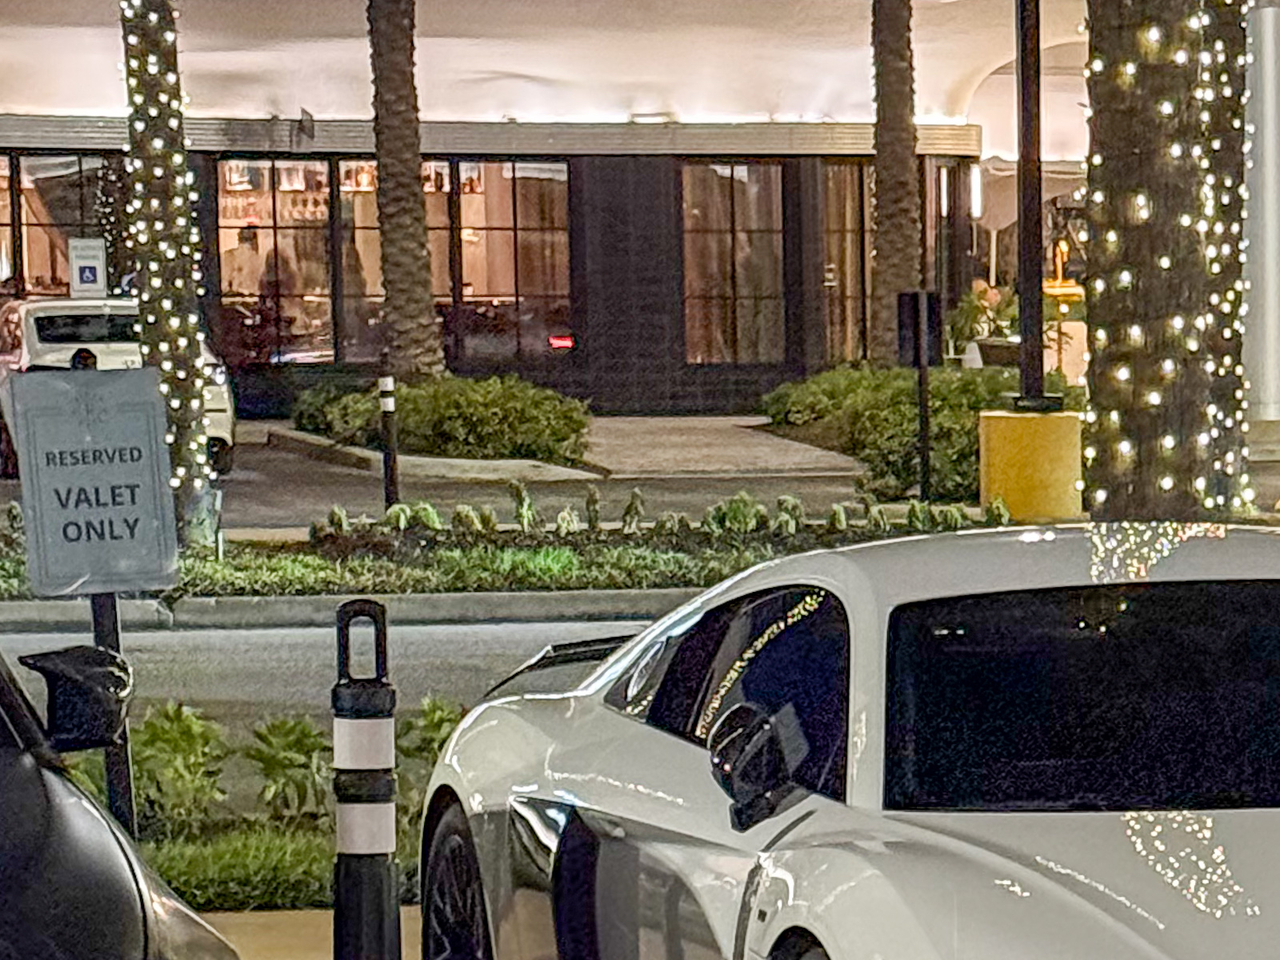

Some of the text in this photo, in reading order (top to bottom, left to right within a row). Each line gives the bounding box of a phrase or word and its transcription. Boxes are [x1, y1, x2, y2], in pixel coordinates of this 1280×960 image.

[45, 446, 142, 467] RESERVED
[53, 484, 140, 510] VALET
[62, 517, 139, 543] ONLY
